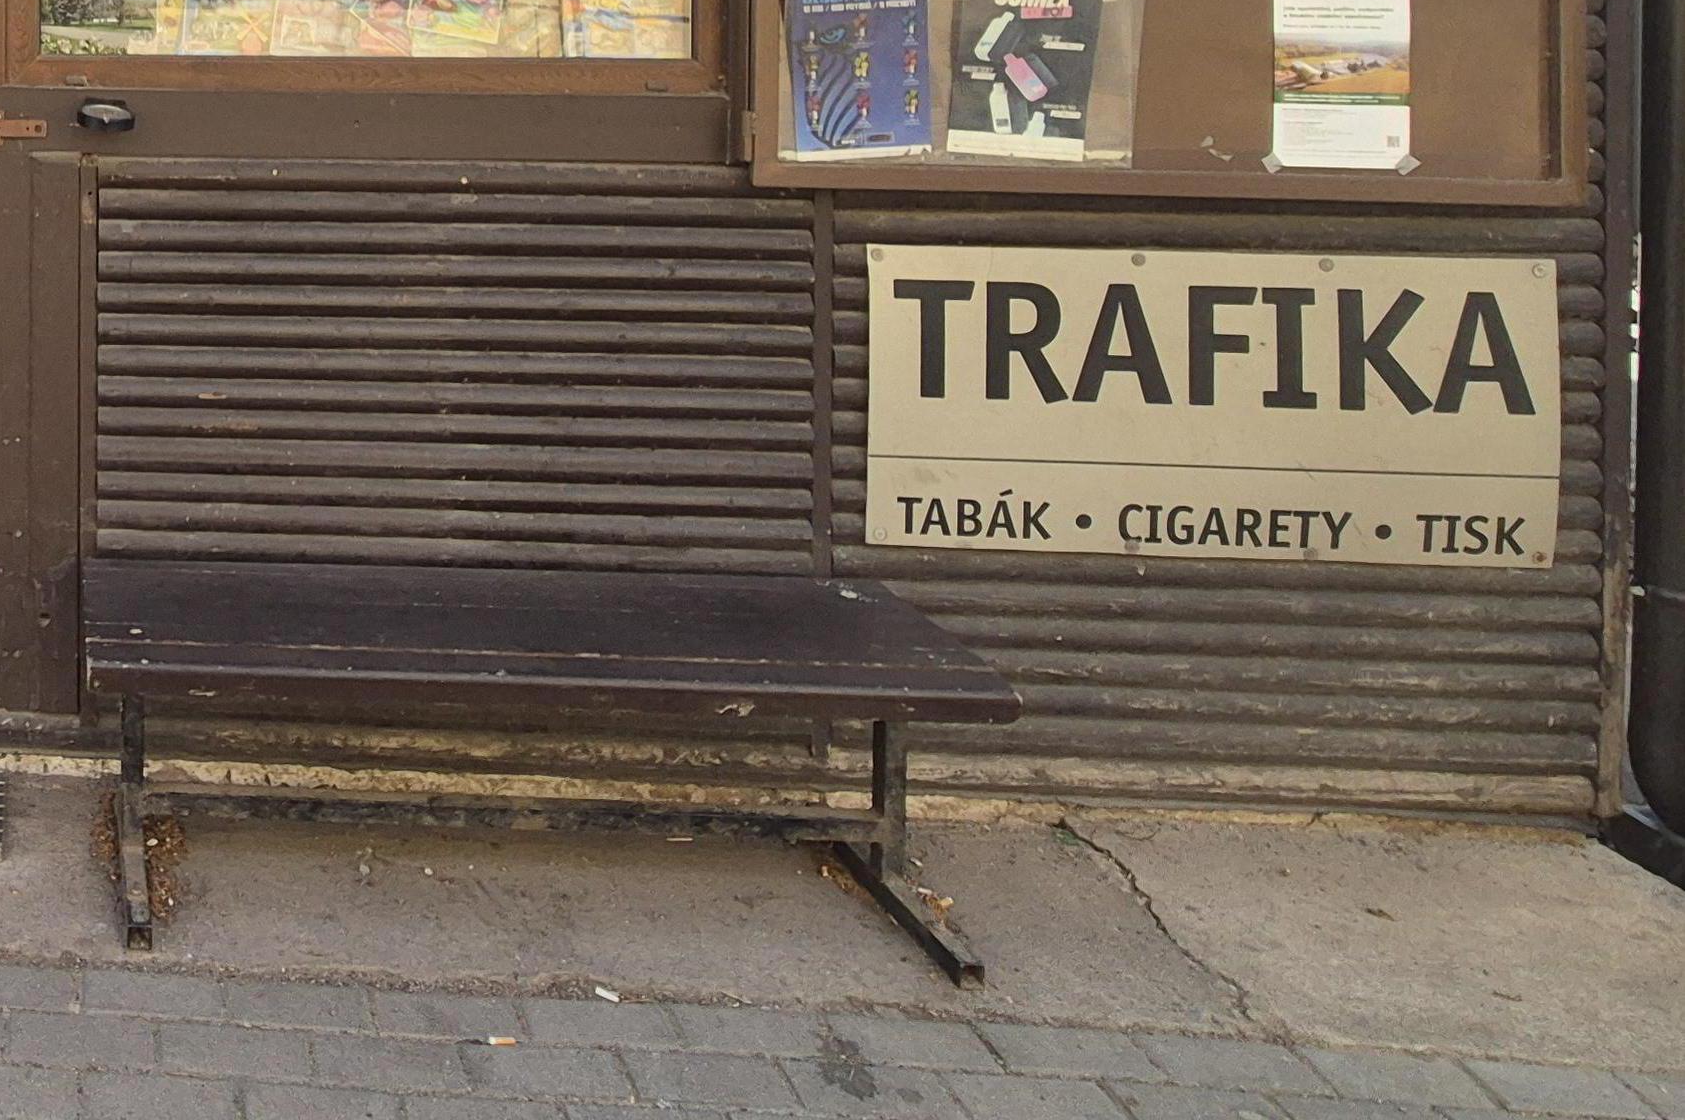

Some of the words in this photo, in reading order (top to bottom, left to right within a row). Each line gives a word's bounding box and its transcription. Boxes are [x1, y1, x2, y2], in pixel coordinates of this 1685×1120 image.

[893, 278, 1537, 417] TRAFIKA
[897, 489, 1051, 541] TABÁK
[1119, 502, 1353, 551] CIGARETY
[1417, 512, 1526, 556] TISK
